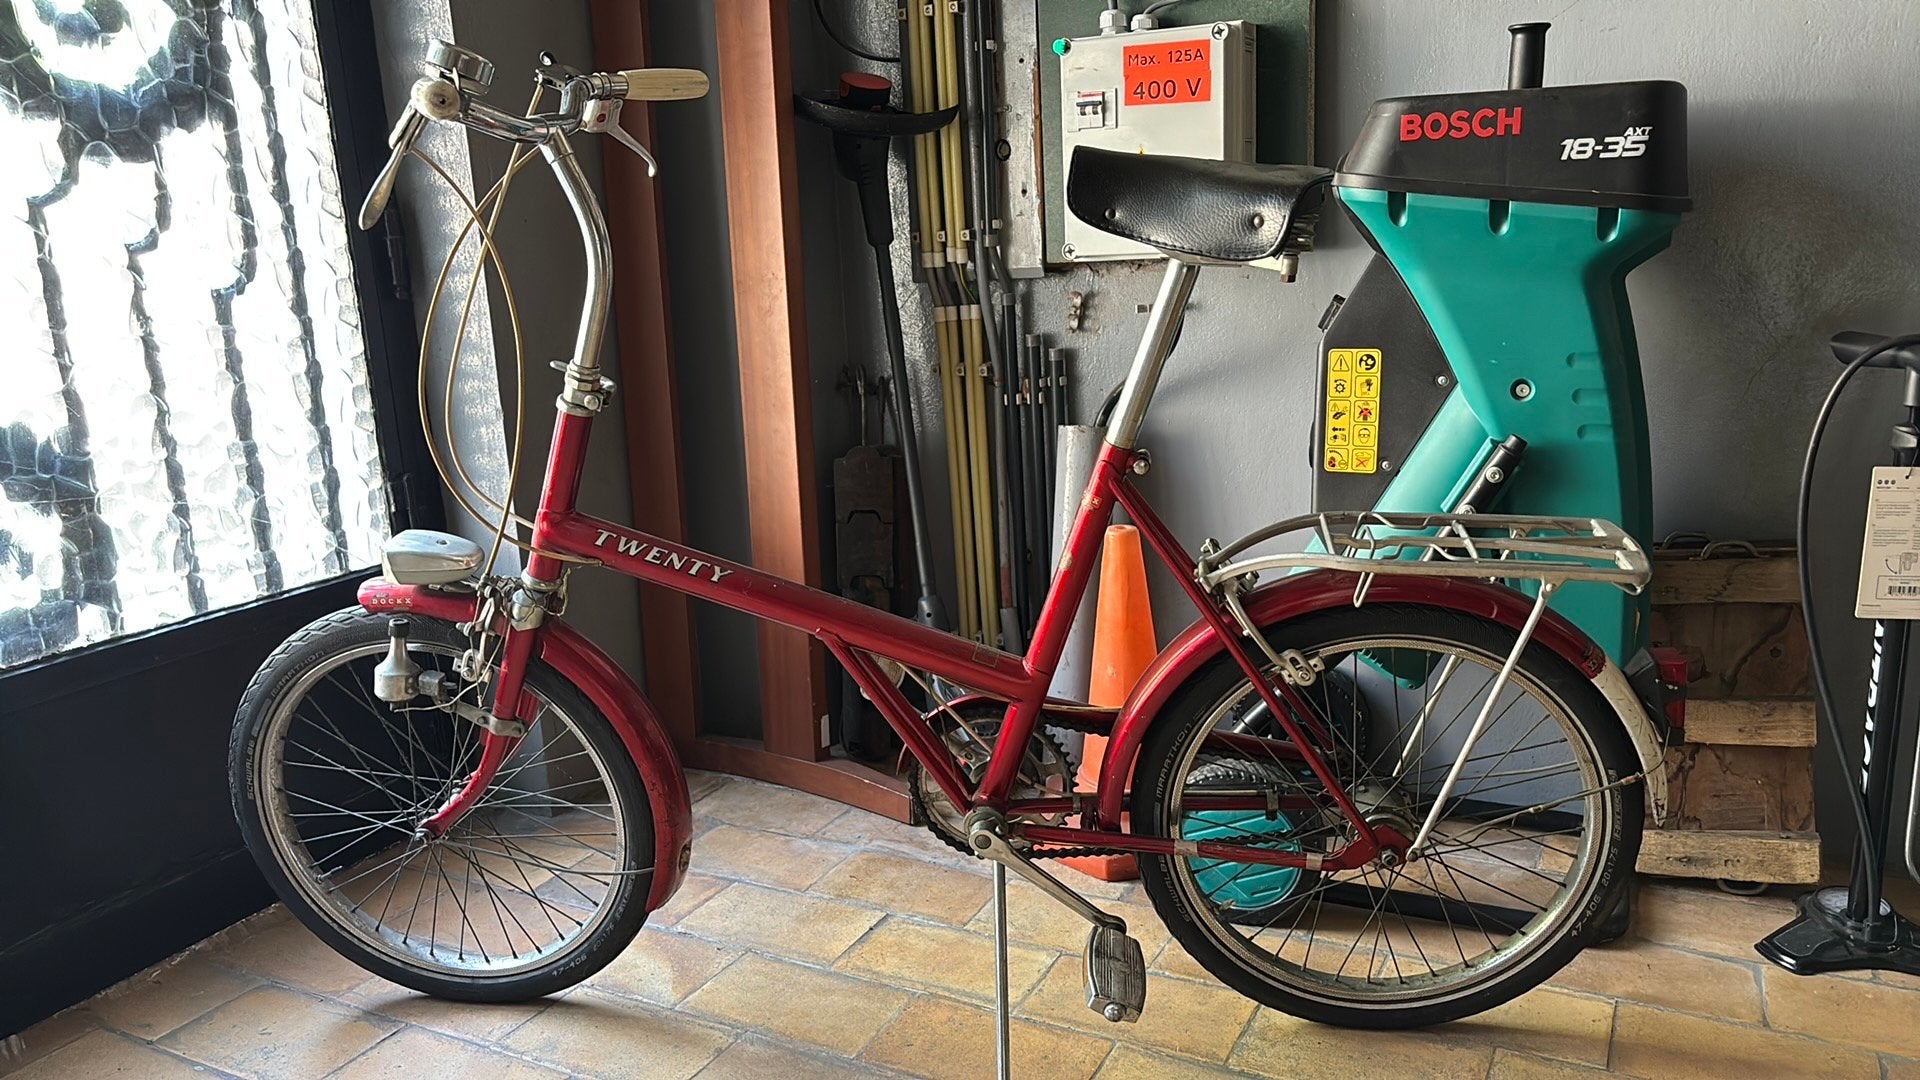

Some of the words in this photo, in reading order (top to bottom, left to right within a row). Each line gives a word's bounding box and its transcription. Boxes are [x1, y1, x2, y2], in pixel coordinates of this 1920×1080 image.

[1128, 53, 1161, 67] Max.
[1168, 48, 1205, 64] 125A
[1132, 79, 1177, 100] 400
[1186, 77, 1202, 97] V
[1399, 106, 1523, 142] BOSCH
[1623, 126, 1654, 137] AXT
[1559, 136, 1650, 161] 18-35
[593, 529, 735, 583] TWENTY
[1570, 894, 1602, 937] 47-406
